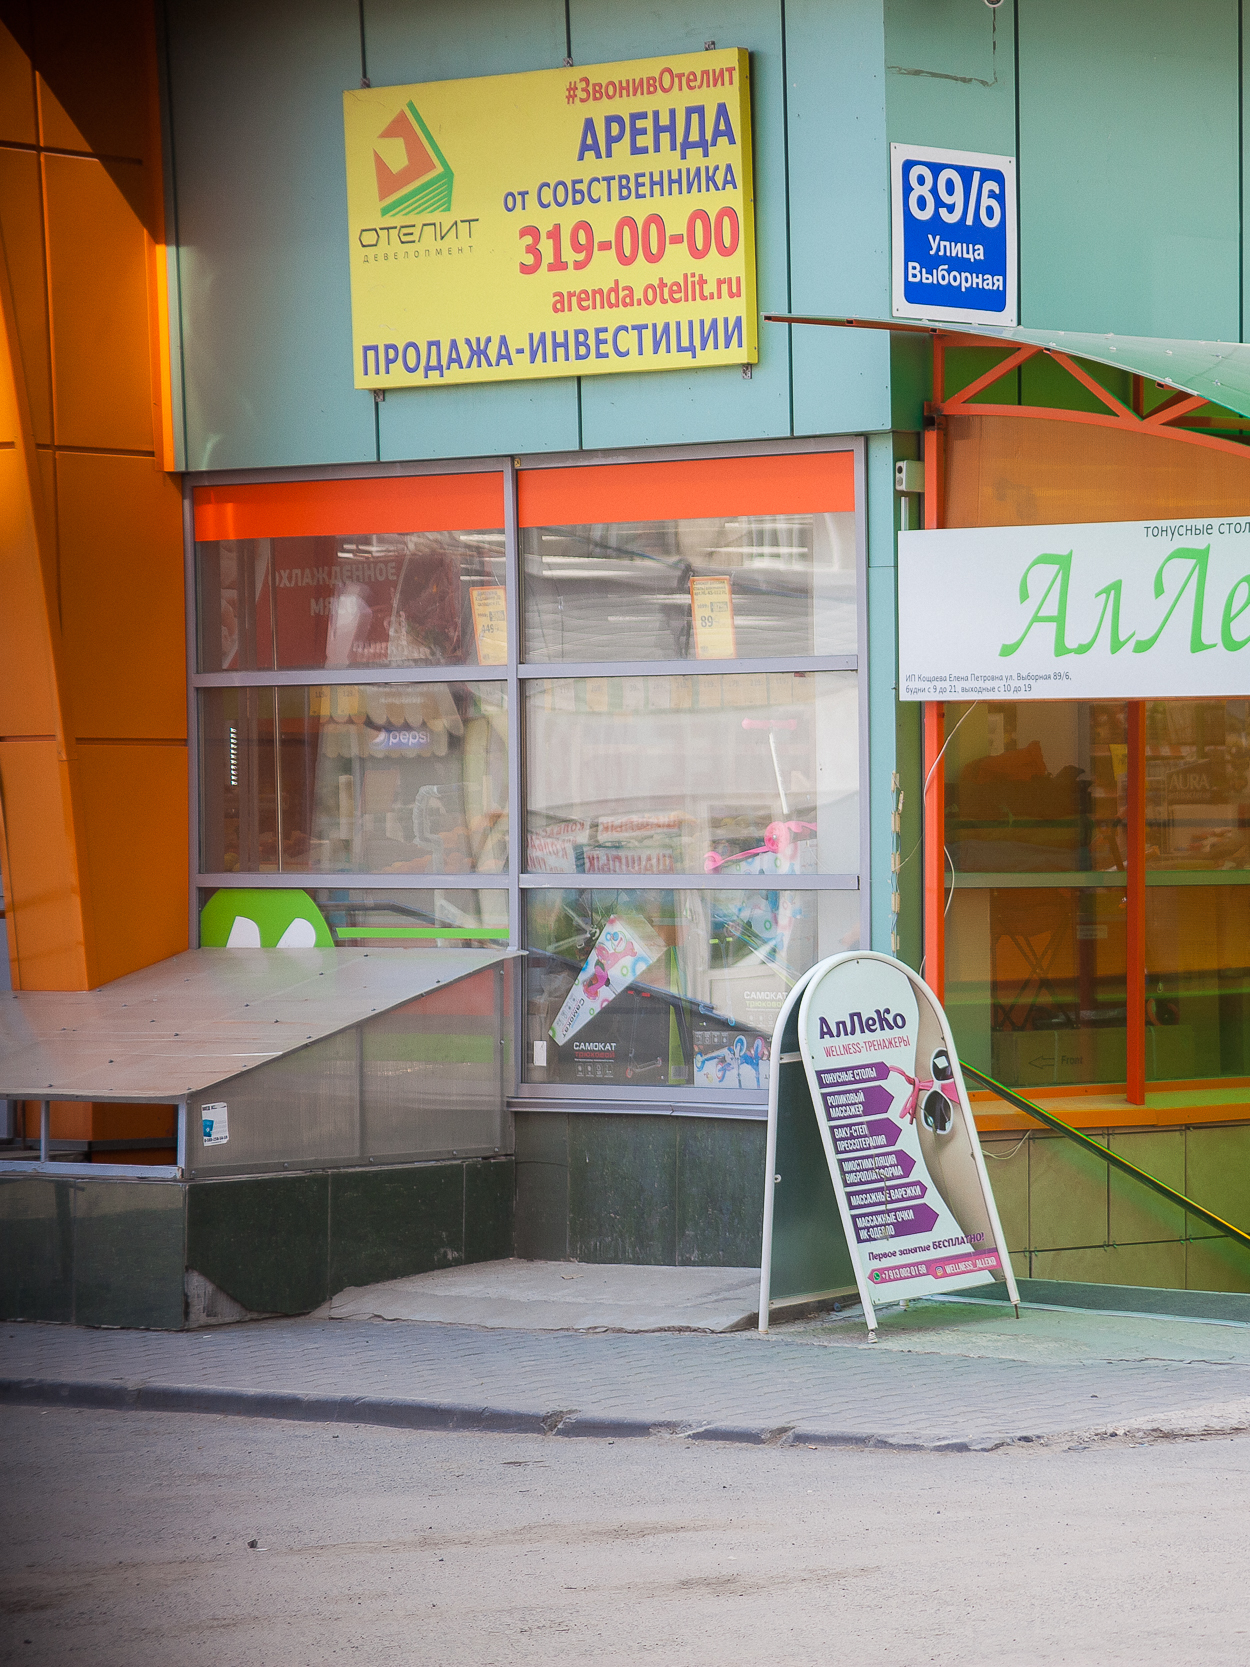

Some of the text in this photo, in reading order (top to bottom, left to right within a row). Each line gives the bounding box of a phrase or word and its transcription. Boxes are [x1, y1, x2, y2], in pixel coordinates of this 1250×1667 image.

[566, 66, 736, 105] #ЗвонивОтелит
[577, 102, 737, 161] АРЕНДА
[503, 163, 738, 213] от СОБСТВЕННИКА
[908, 164, 1001, 228] 89/6
[358, 218, 479, 248] ОТЕЛИТ
[518, 206, 740, 275] 319-00-00
[363, 245, 474, 264] ДЕВЕЛОПМЕНТ
[928, 234, 984, 262] Улица
[907, 261, 1003, 292] Выборная
[552, 272, 742, 313] arenda.otelit.ru
[361, 315, 744, 379] ПРОДАЖА-ИНВЕСТИЦИИ
[1144, 524, 1213, 541] тонусные
[905, 671, 1072, 684] ИП Кощаева Елена Петровна ул. Выборная 89/6,
[905, 685, 926, 695] будни
[933, 685, 938, 693] 9
[938, 686, 948, 694] до
[948, 685, 960, 694] 21,
[960, 686, 996, 694] выходные
[1003, 684, 1012, 693] 10
[1012, 685, 1022, 694] до
[1023, 684, 1032, 692] 19
[390, 730, 430, 746] pepsi
[1169, 773, 1210, 790] AURA
[744, 991, 788, 1000] САМОКАТ
[819, 1008, 906, 1039] АлЛеКо
[573, 1042, 617, 1051] САМОКАТ
[823, 1035, 910, 1057] WELLNESS-ТРЕНАЖЕРЫ
[1061, 1055, 1083, 1065] Front
[821, 1067, 877, 1084] ТОНУСНЫЕ СТОЛЫ
[827, 1090, 865, 1106] РОЛИКОВЫЙ
[829, 1105, 863, 1117] МАССАЖЕР
[834, 1124, 868, 1138] ВАКУ-СТЕП
[837, 1135, 887, 1151] ПРЕССОТЕРАПИЯ
[842, 1154, 897, 1171] МИОСТИМУЛЯЦИЯ
[845, 1166, 903, 1183] ВИБРОПЛАТФОРМА
[850, 1185, 922, 1206] МАССАЖНЫЕ ВАРЕЖКИ
[856, 1209, 914, 1227] МАССАЖНЫЕ ОЧКИ
[868, 1232, 985, 1262] Первое занятие БЕСПЛАТНО!
[881, 1272, 889, 1281] +7
[888, 1269, 900, 1279] 913
[944, 1257, 996, 1275] WELLNESS_ALLEKO
